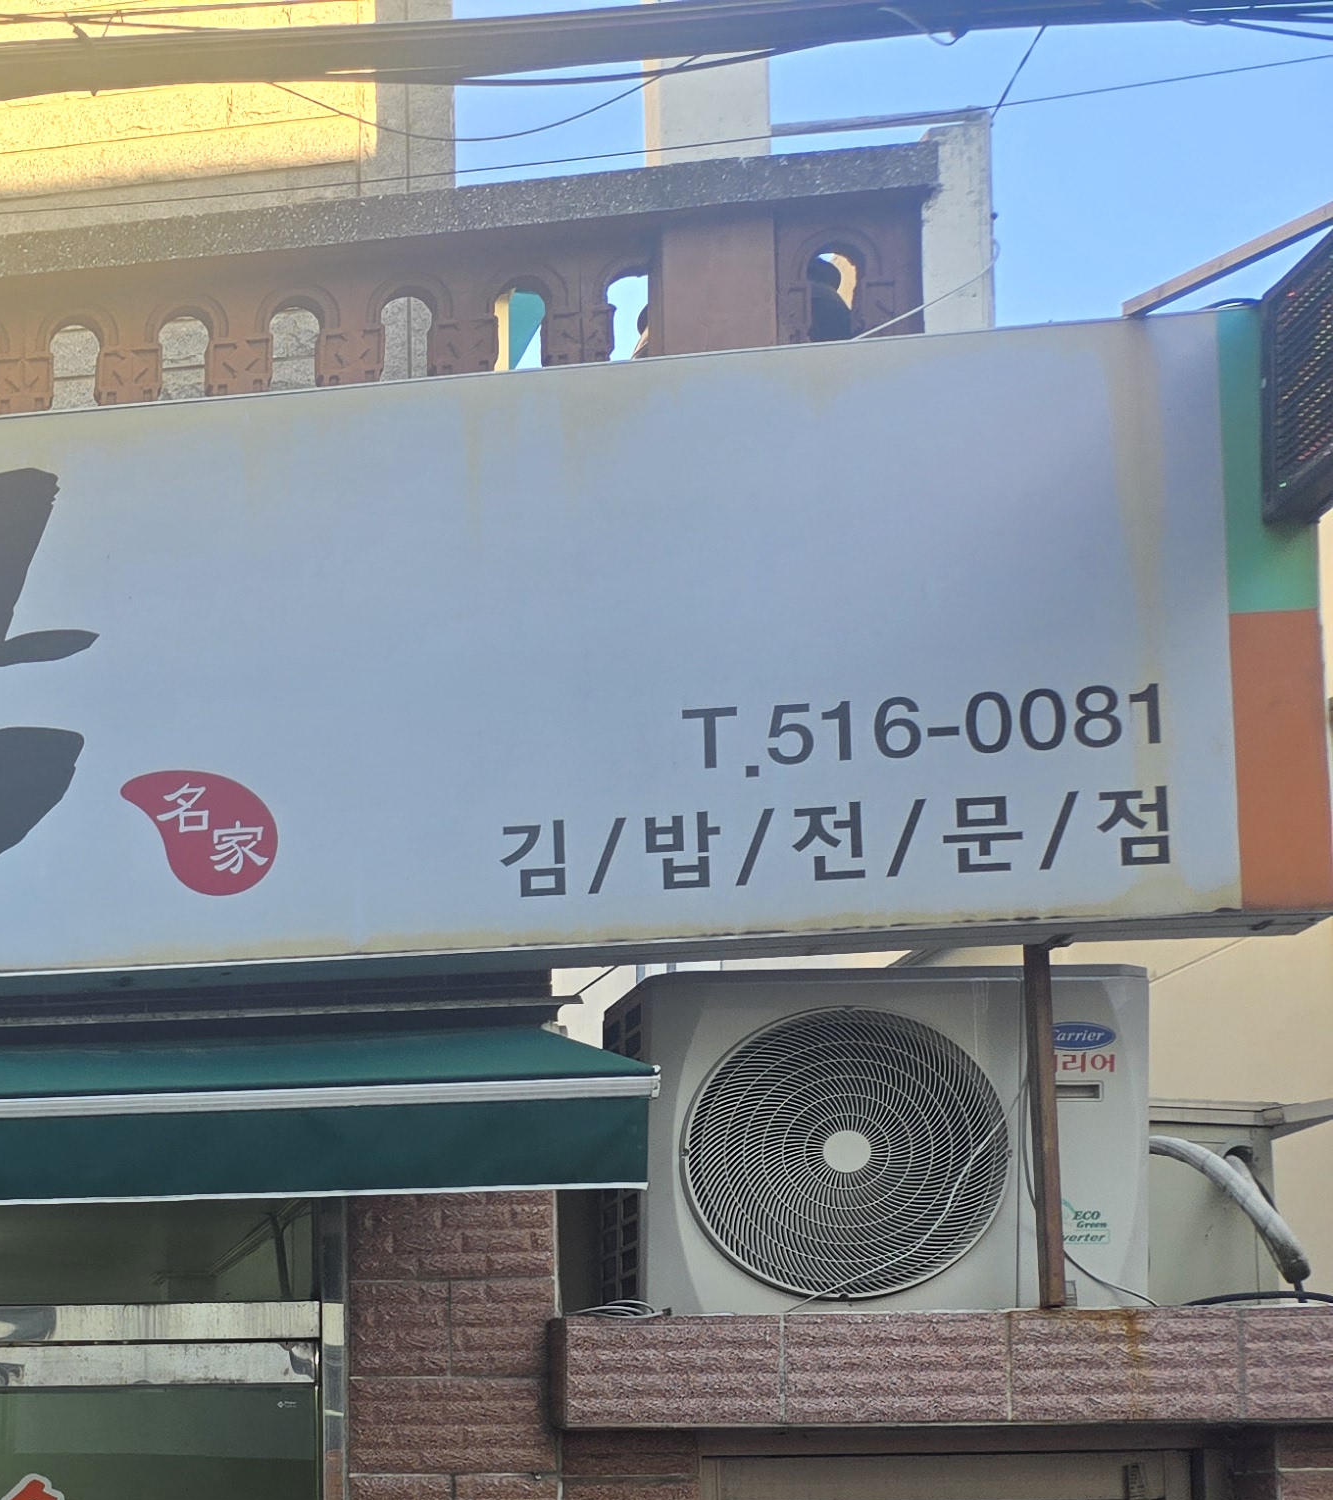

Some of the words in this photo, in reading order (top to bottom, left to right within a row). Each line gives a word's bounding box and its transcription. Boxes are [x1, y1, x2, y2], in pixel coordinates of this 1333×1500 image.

[682, 683, 1165, 777] T.516-0081
[500, 786, 1171, 898] 김/밥/전/문/점
[1054, 1052, 1116, 1073] 리어
[1072, 1210, 1102, 1221] ECO
